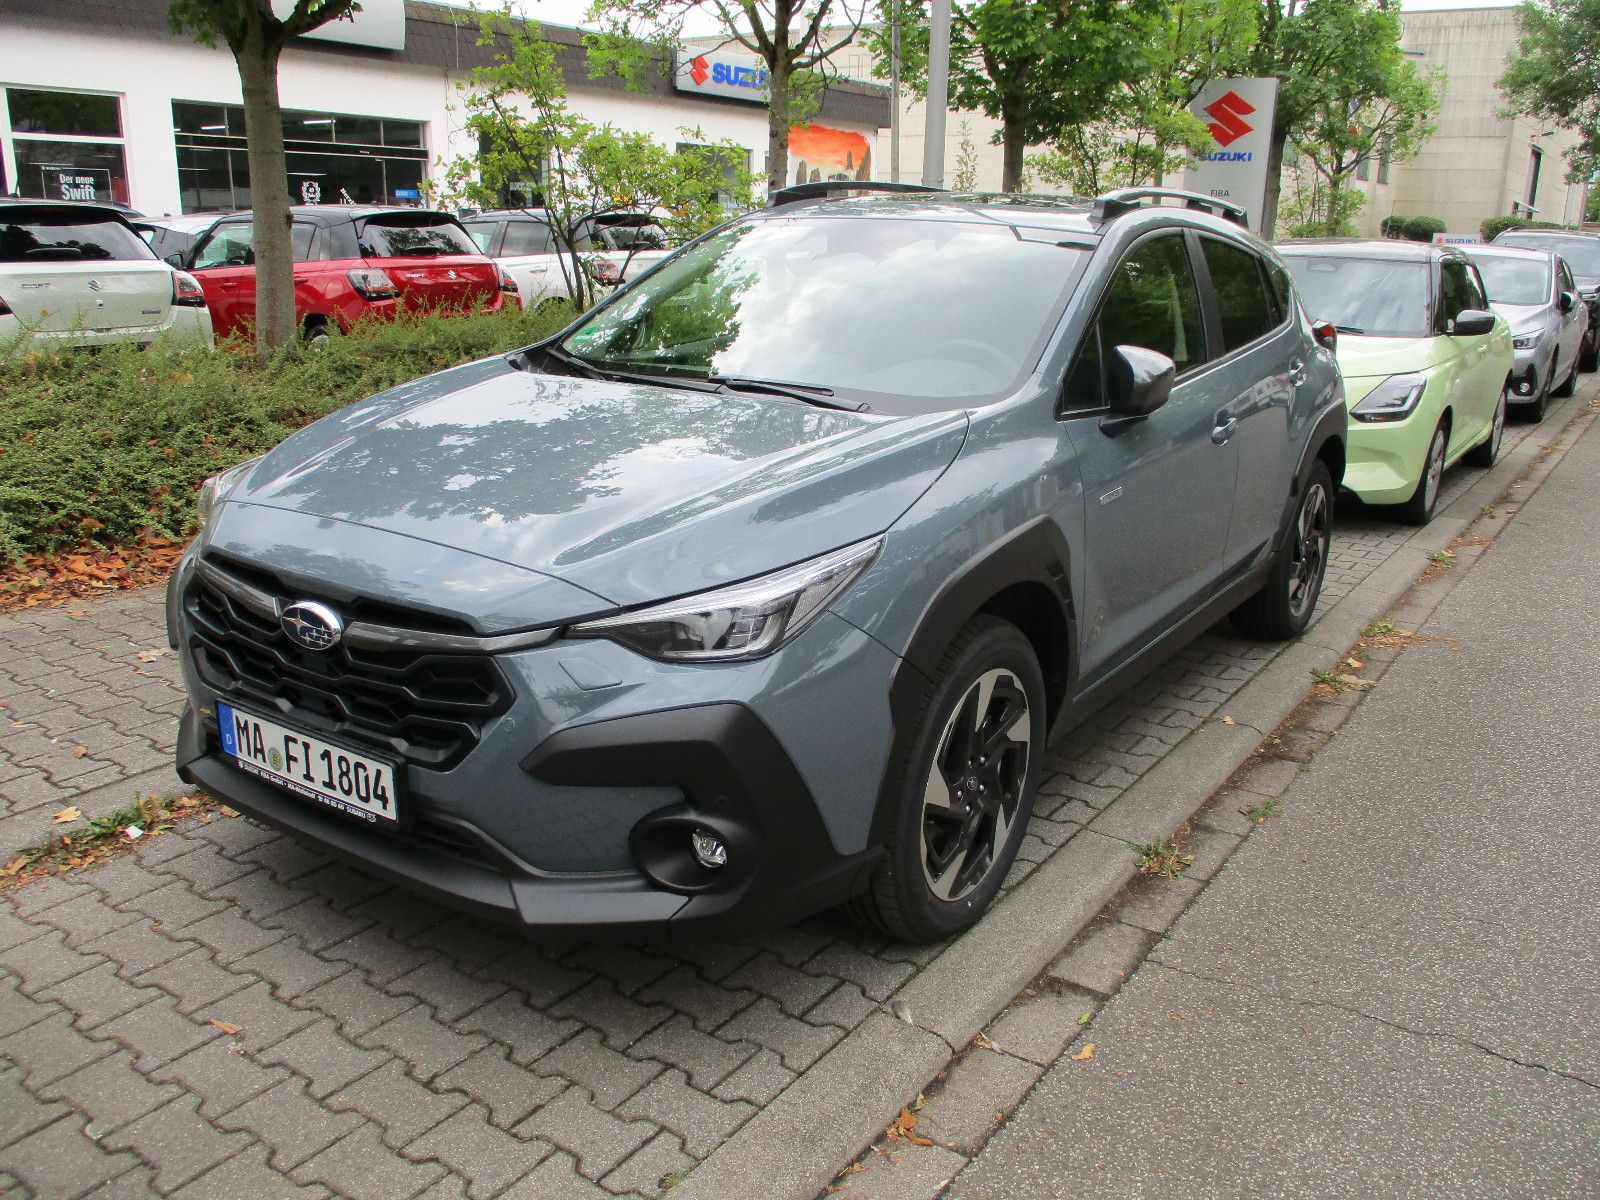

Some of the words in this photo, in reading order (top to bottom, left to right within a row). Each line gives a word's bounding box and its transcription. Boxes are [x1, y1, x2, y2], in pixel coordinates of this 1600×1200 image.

[712, 62, 768, 90] SUZU
[60, 173, 73, 184] Der
[75, 176, 95, 184] neue
[61, 184, 96, 200] Swift
[1210, 189, 1230, 198] FIBA
[235, 715, 267, 764] MA
